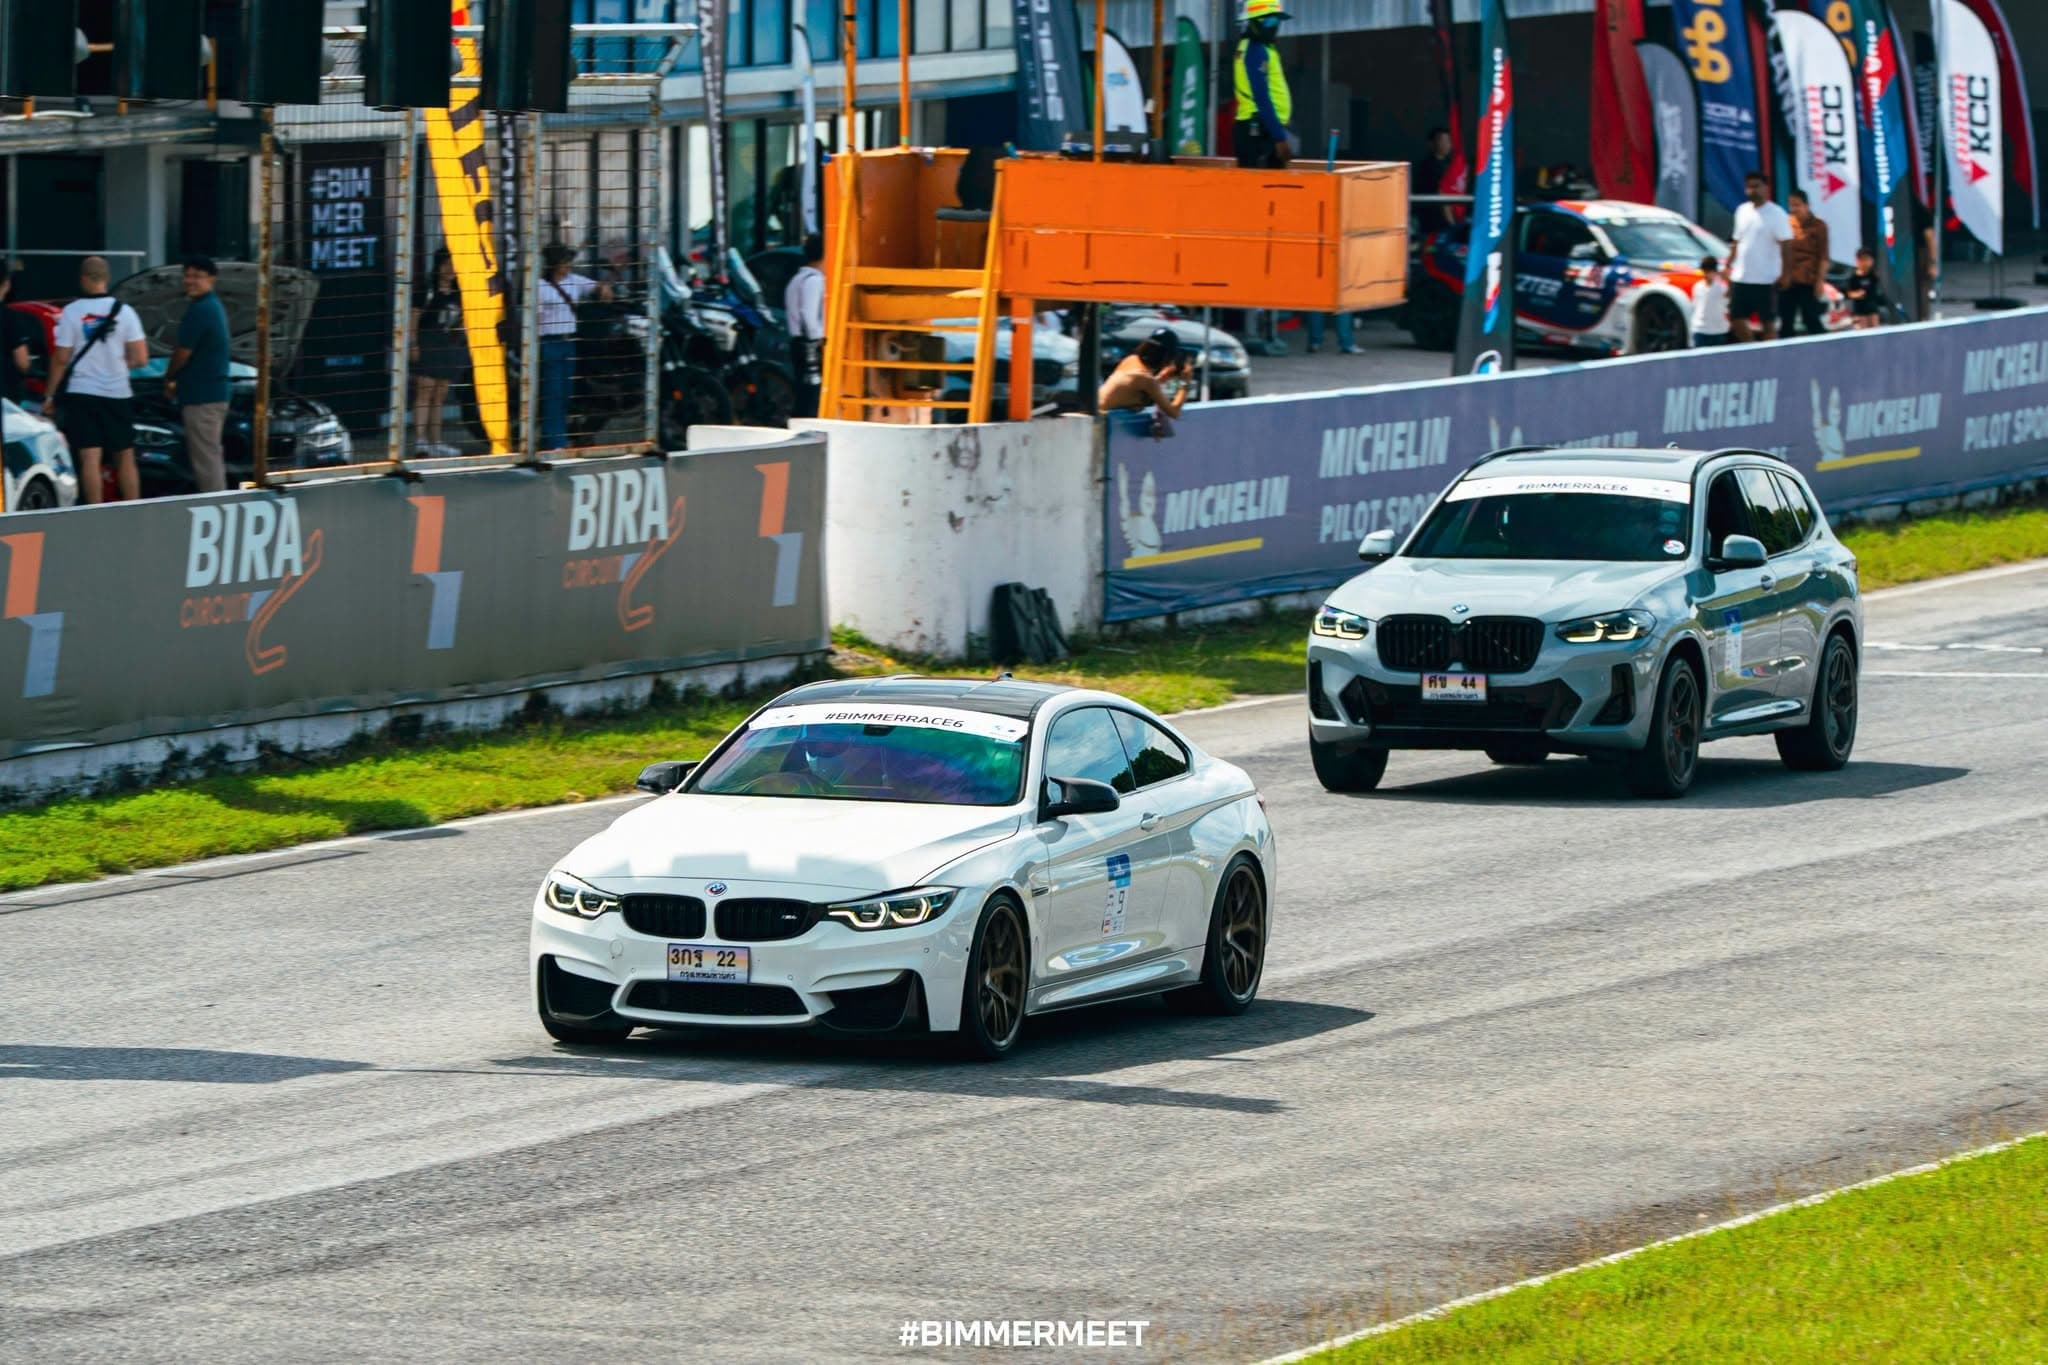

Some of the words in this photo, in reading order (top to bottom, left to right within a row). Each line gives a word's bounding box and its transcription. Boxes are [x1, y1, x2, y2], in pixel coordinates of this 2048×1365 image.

[309, 166, 372, 199] #BIM
[311, 202, 365, 235] MER
[311, 236, 378, 270] MEET
[1963, 341, 2048, 395] MICHELI
[1663, 378, 1779, 434] MICHELIN
[1846, 392, 1942, 441] MICHELIN
[1963, 411, 2012, 452] PILOT
[2012, 404, 2048, 445] SPO
[1319, 416, 1452, 479] MICHELIN
[567, 466, 669, 552] BIRA
[1162, 475, 1290, 535] MICHELIN
[1319, 499, 1382, 544] PILOT
[185, 497, 303, 589] BIRA
[1460, 675, 1476, 689] 44
[824, 712, 965, 728] #BIMMERRACE6
[716, 950, 737, 968] 22
